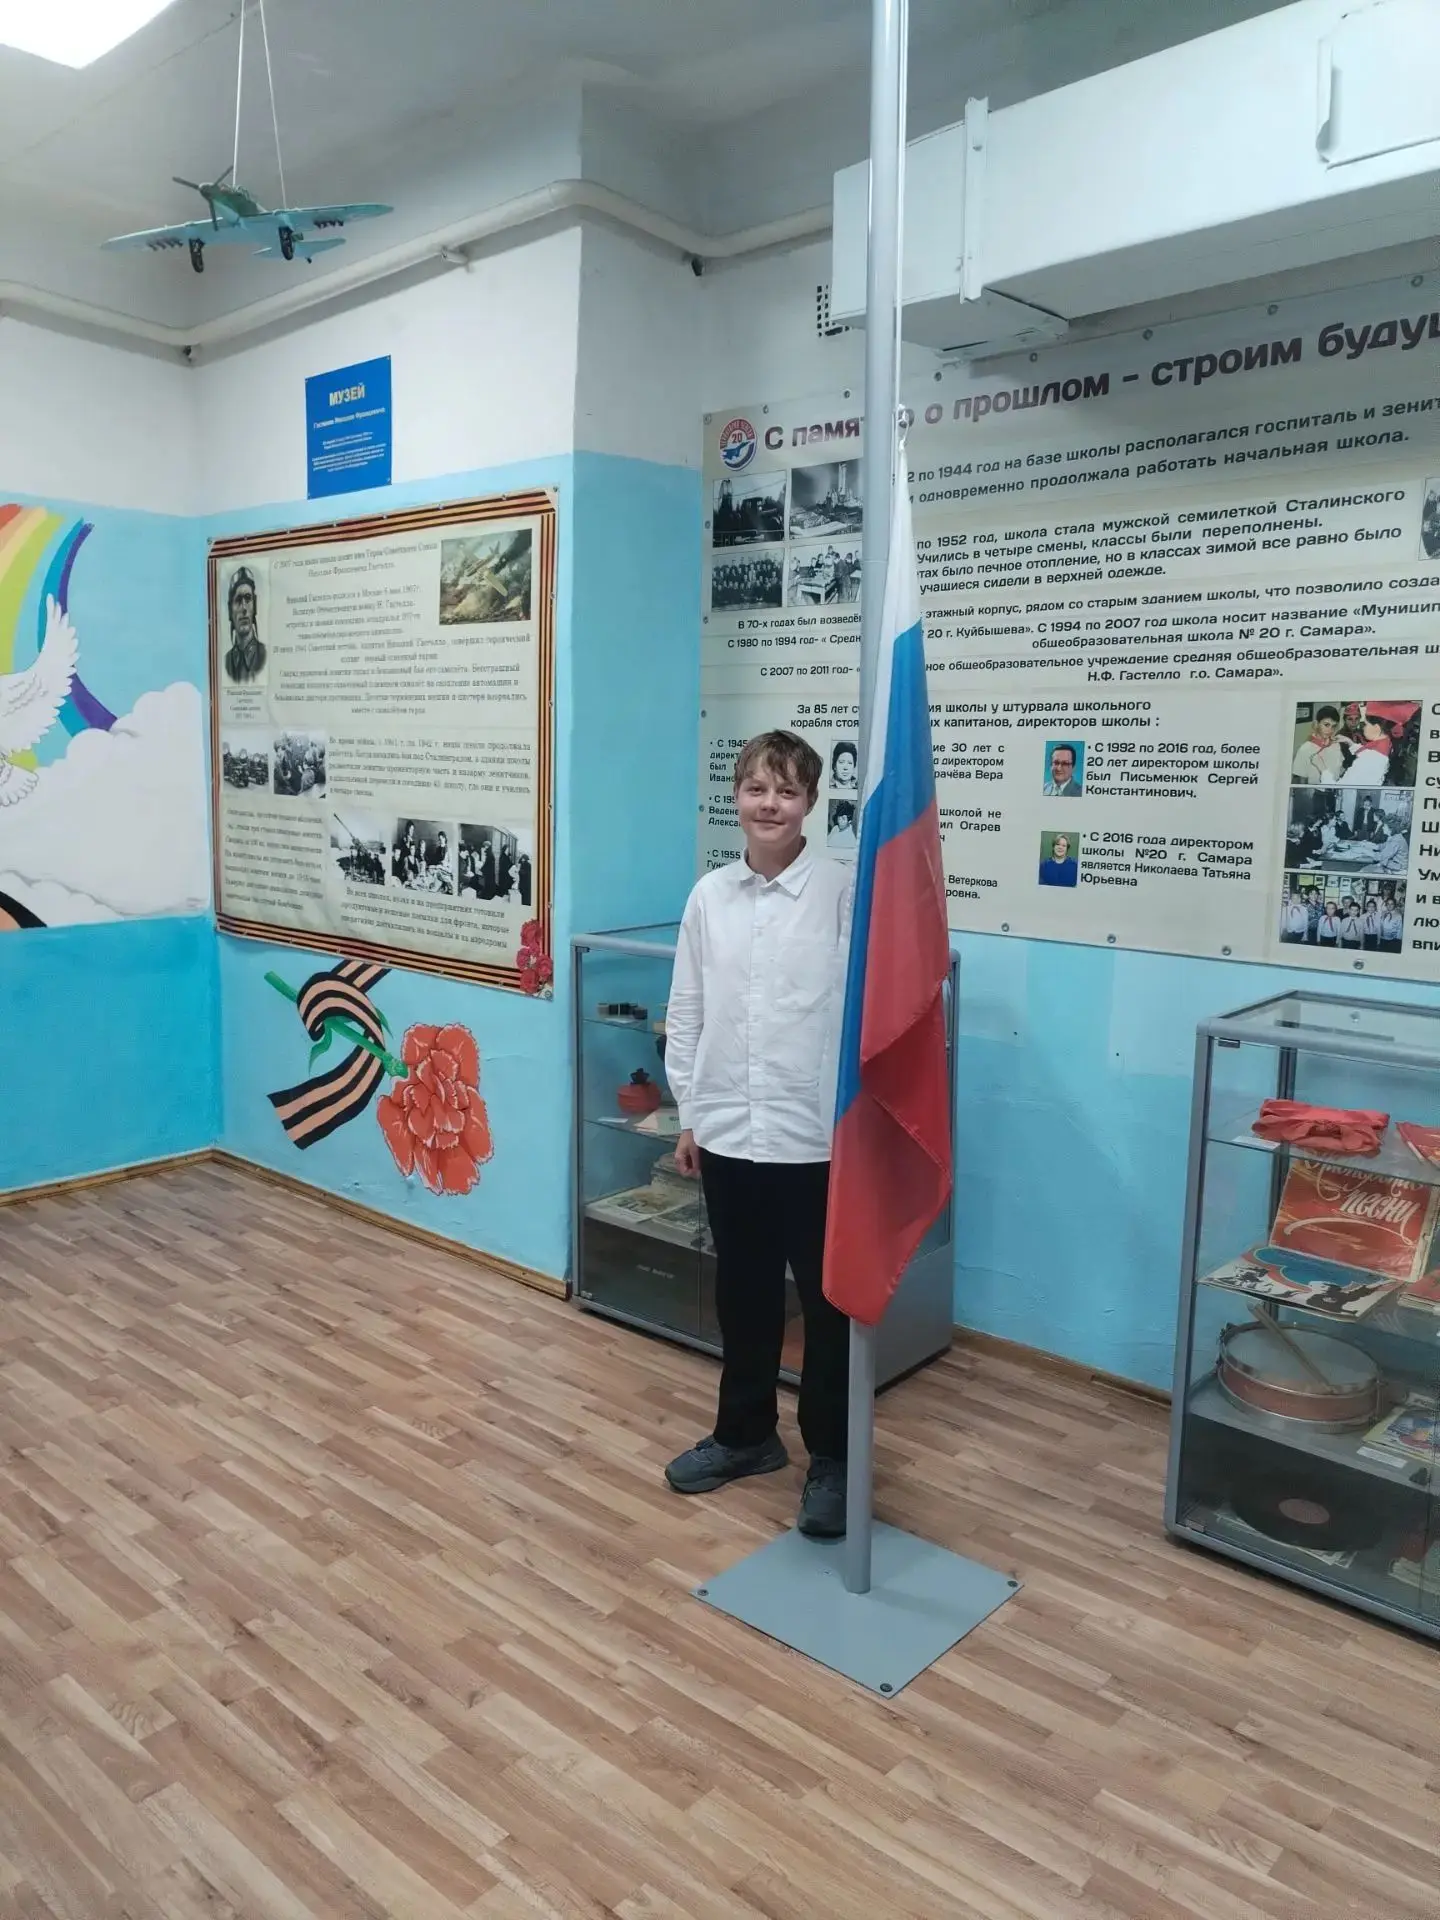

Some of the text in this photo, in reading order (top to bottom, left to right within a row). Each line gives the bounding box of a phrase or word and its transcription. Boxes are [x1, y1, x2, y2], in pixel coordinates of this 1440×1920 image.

[329, 382, 365, 406] МУЗЕЙ
[765, 427, 783, 450] С
[924, 403, 942, 424] о
[953, 372, 1109, 422] прошлом
[1151, 337, 1302, 386] строим
[918, 407, 1375, 481] по 1944 год на базе школы располагался госпиталь и
[919, 430, 1408, 502] одновременно продолжала работать начальная школа.
[917, 490, 1404, 549] по 1952 год, школа стала мужской семилеткой Сталинского
[916, 517, 1322, 564] Учились в четыре смены, классы были переполнены.
[942, 566, 973, 576] было
[977, 561, 1022, 573] печное
[1026, 555, 1100, 569] отопление,
[1105, 552, 1122, 562] но
[1126, 551, 1135, 560] в
[1140, 546, 1200, 559] классах
[1206, 541, 1256, 554] зимой
[1296, 532, 1348, 548] равно
[1354, 527, 1401, 541] было
[983, 576, 1029, 588] сидели
[1034, 575, 1042, 584] в
[1046, 567, 1102, 584] верхней
[1107, 565, 1165, 578] одежде.
[738, 580, 1382, 629] В 70-х годах был этажный корпус, рядом со старым зданием школы, что позволило
[736, 608, 1347, 647] 1980 1994 20 Куйбышева». С 1994 по 2007 год школа носит название
[1187, 631, 1233, 642] школа
[1259, 627, 1280, 638] 20
[1285, 628, 1294, 637] г.
[769, 666, 794, 676] 2007
[810, 665, 829, 674] 2011
[1087, 654, 1168, 667] учреждение
[1173, 652, 1231, 664] средняя
[1087, 670, 1114, 681] Н.Ф.
[1119, 670, 1180, 680] Гастелло
[797, 701, 1151, 714] За 85 лет школы у штурвала школьного
[790, 717, 1150, 728] корабля капитанов, директоров школы
[951, 742, 967, 752] 30
[1094, 742, 1260, 755] С 1992 по 2016 год, более
[941, 758, 1004, 767] директором
[1086, 756, 1258, 770] 20 лет директором школы
[975, 769, 1003, 781] Вера
[1086, 770, 1258, 786] был Письменюк Сергей
[1086, 784, 1196, 798] Константинович.
[939, 807, 982, 817] школой
[959, 820, 1000, 832] Огарев
[1090, 831, 1253, 850] С 2016 года директором
[1082, 847, 1124, 857] школы
[1178, 852, 1186, 861] г.
[1197, 851, 1252, 866] Самара
[1081, 861, 1250, 880] является Николаева Татьяна
[948, 874, 997, 887] Ветеркова
[1080, 872, 1137, 886] Юрьевна
